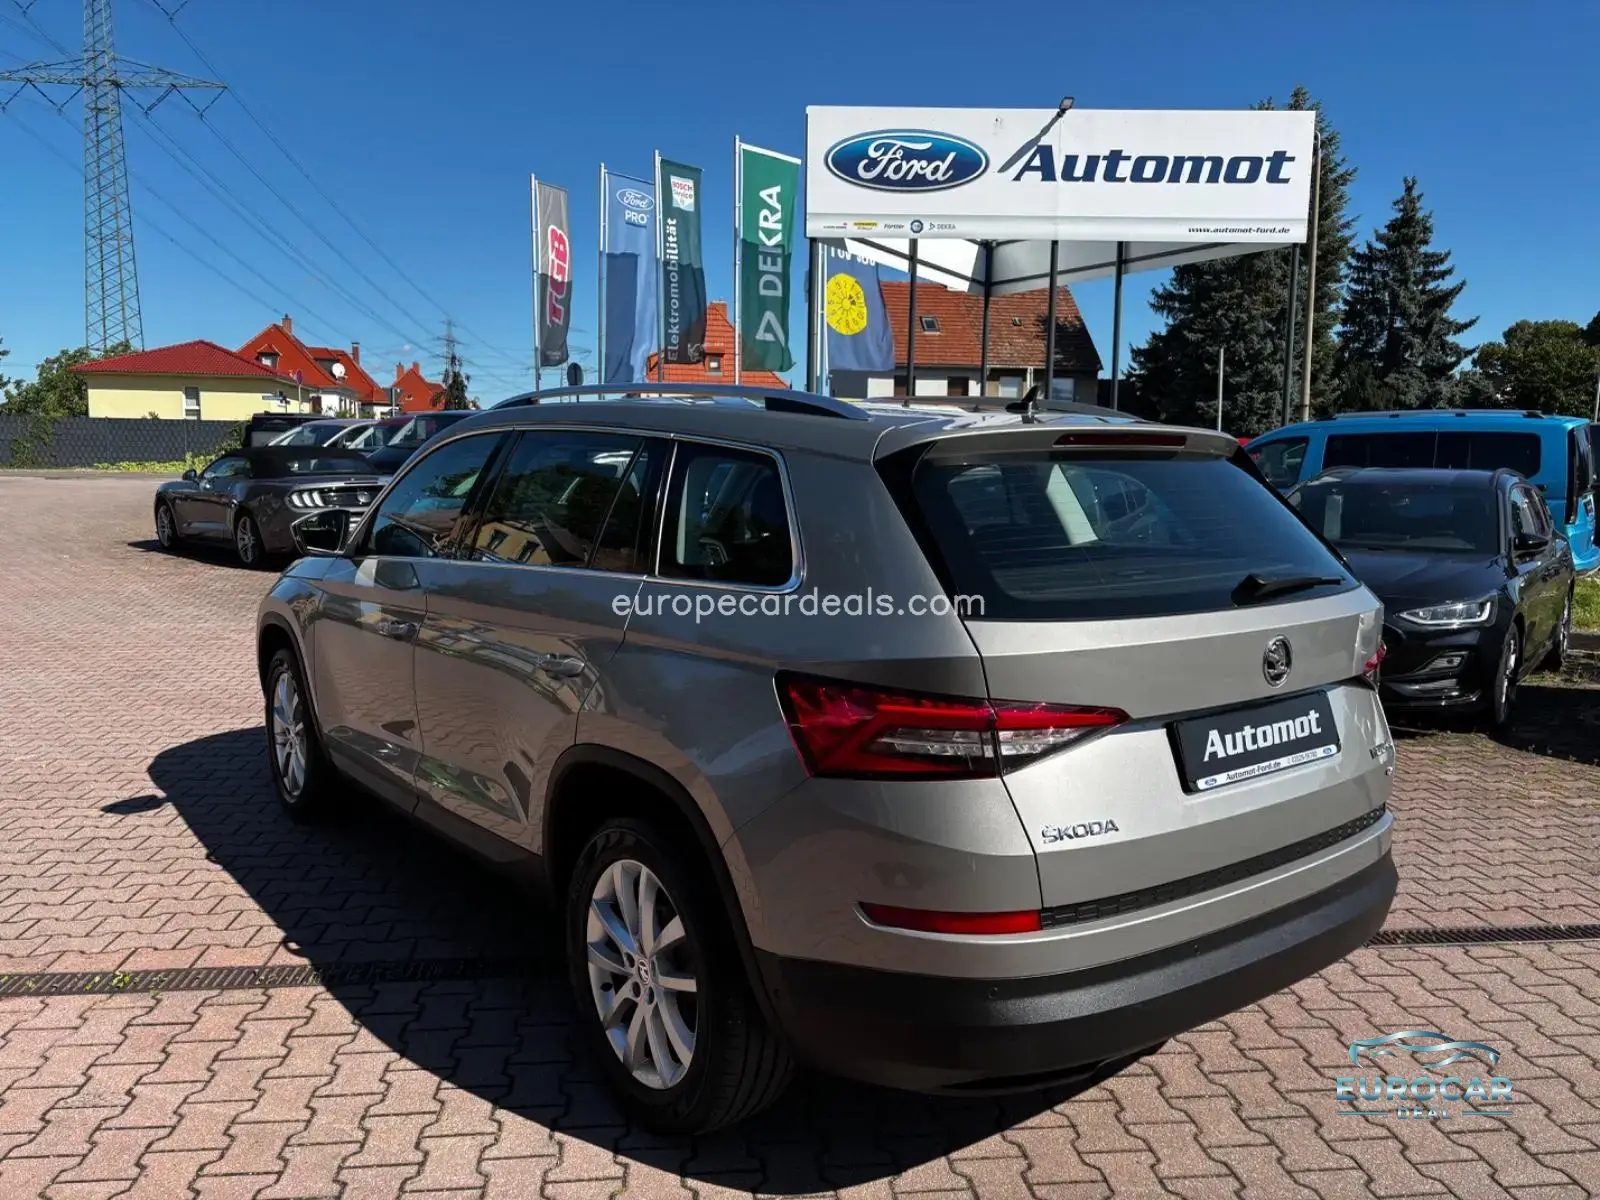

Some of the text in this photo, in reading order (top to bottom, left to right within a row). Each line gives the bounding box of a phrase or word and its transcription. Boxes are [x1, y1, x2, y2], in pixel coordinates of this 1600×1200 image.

[857, 139, 1296, 185] Ford Automot
[623, 190, 649, 208] Ford
[625, 210, 648, 224] PRO
[1188, 226, 1290, 234] www.automot-ford.de
[758, 184, 782, 297] DEKRA
[666, 217, 680, 361] Elektromobilität
[1203, 709, 1322, 762] Automot
[1226, 760, 1282, 782] Automot-Ford.de
